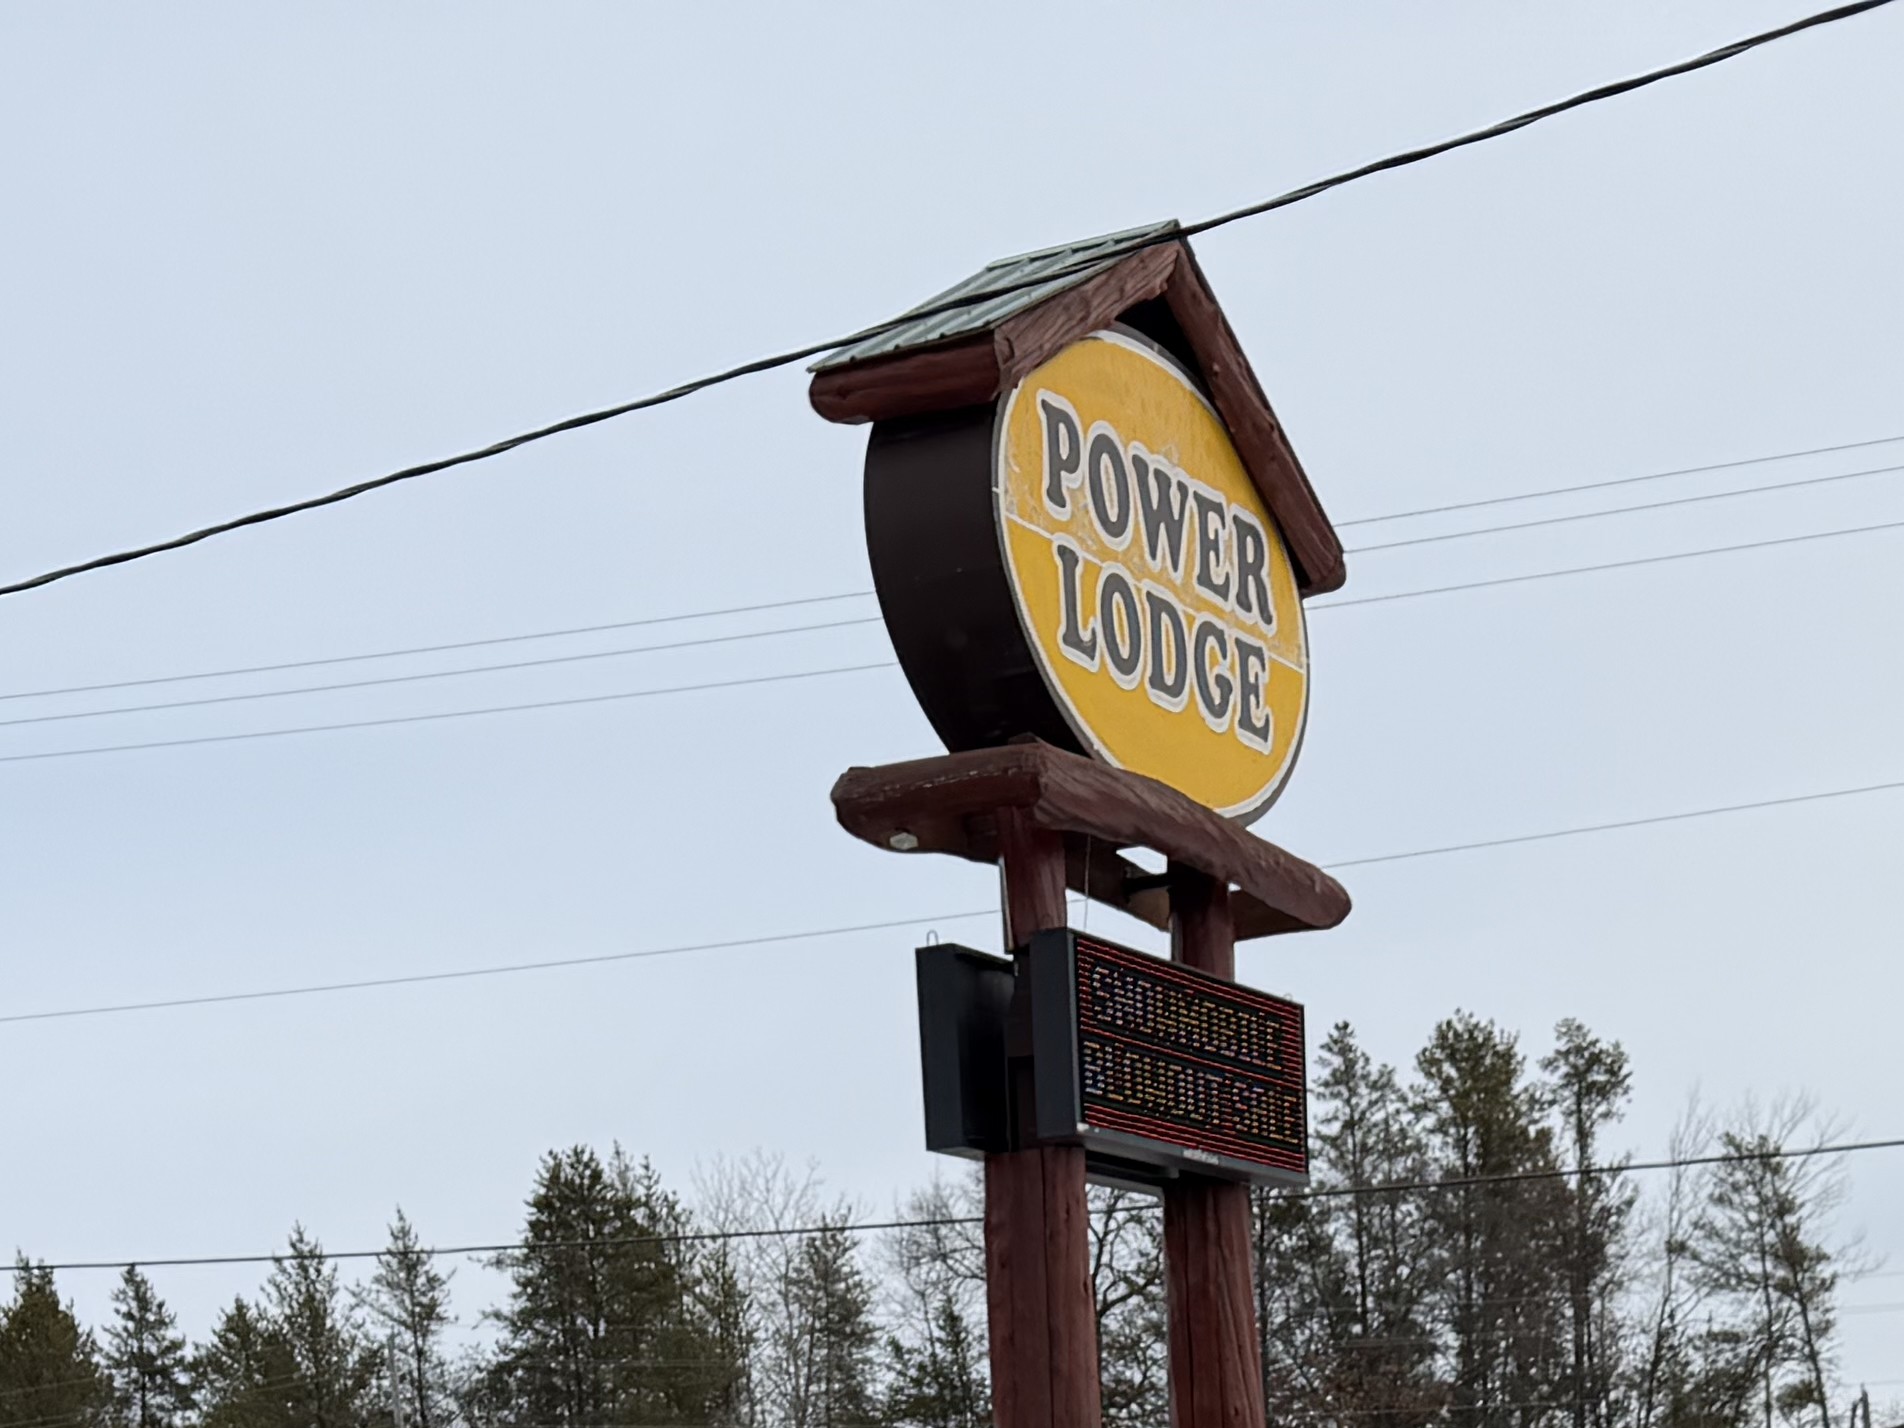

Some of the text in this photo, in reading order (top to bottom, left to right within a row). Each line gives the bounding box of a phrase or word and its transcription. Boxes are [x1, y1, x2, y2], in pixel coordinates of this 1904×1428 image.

[1038, 393, 1275, 630] POWER
[1053, 540, 1274, 745] LODGE
[1081, 1038, 1299, 1145] BLOWOUT SALE
[1091, 964, 1282, 1071] SNOWMOBILE
